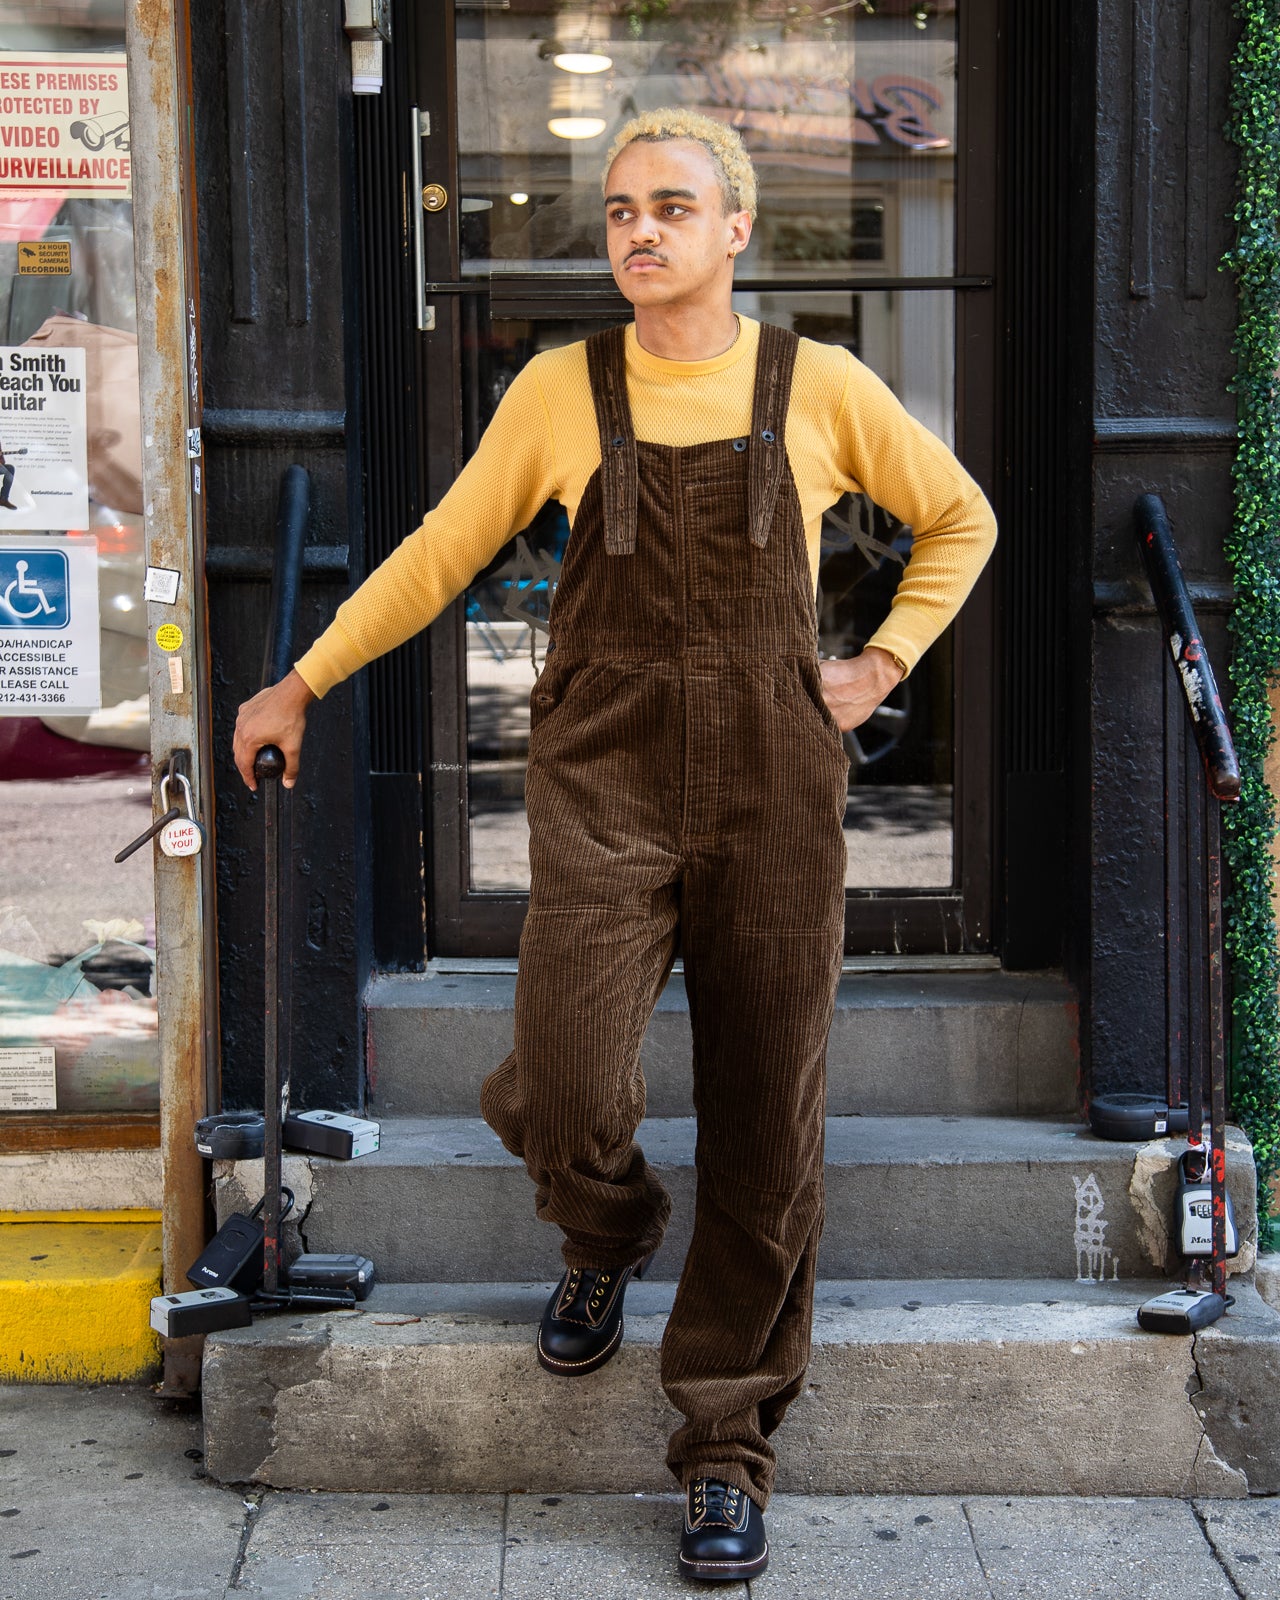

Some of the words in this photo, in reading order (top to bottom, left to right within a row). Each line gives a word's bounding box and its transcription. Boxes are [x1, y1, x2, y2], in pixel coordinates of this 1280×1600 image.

[36, 73, 118, 91] PREMISES
[0, 97, 73, 114] OTECTED
[80, 98, 100, 115] BY
[1, 126, 60, 148] VIDEO
[10, 353, 66, 373] Smith
[0, 373, 43, 392] each
[48, 374, 81, 392] You
[9, 667, 78, 676] ASSISTANCE
[40, 680, 69, 689] CALL
[174, 828, 194, 838] LIKE
[171, 839, 193, 849] YOU!
